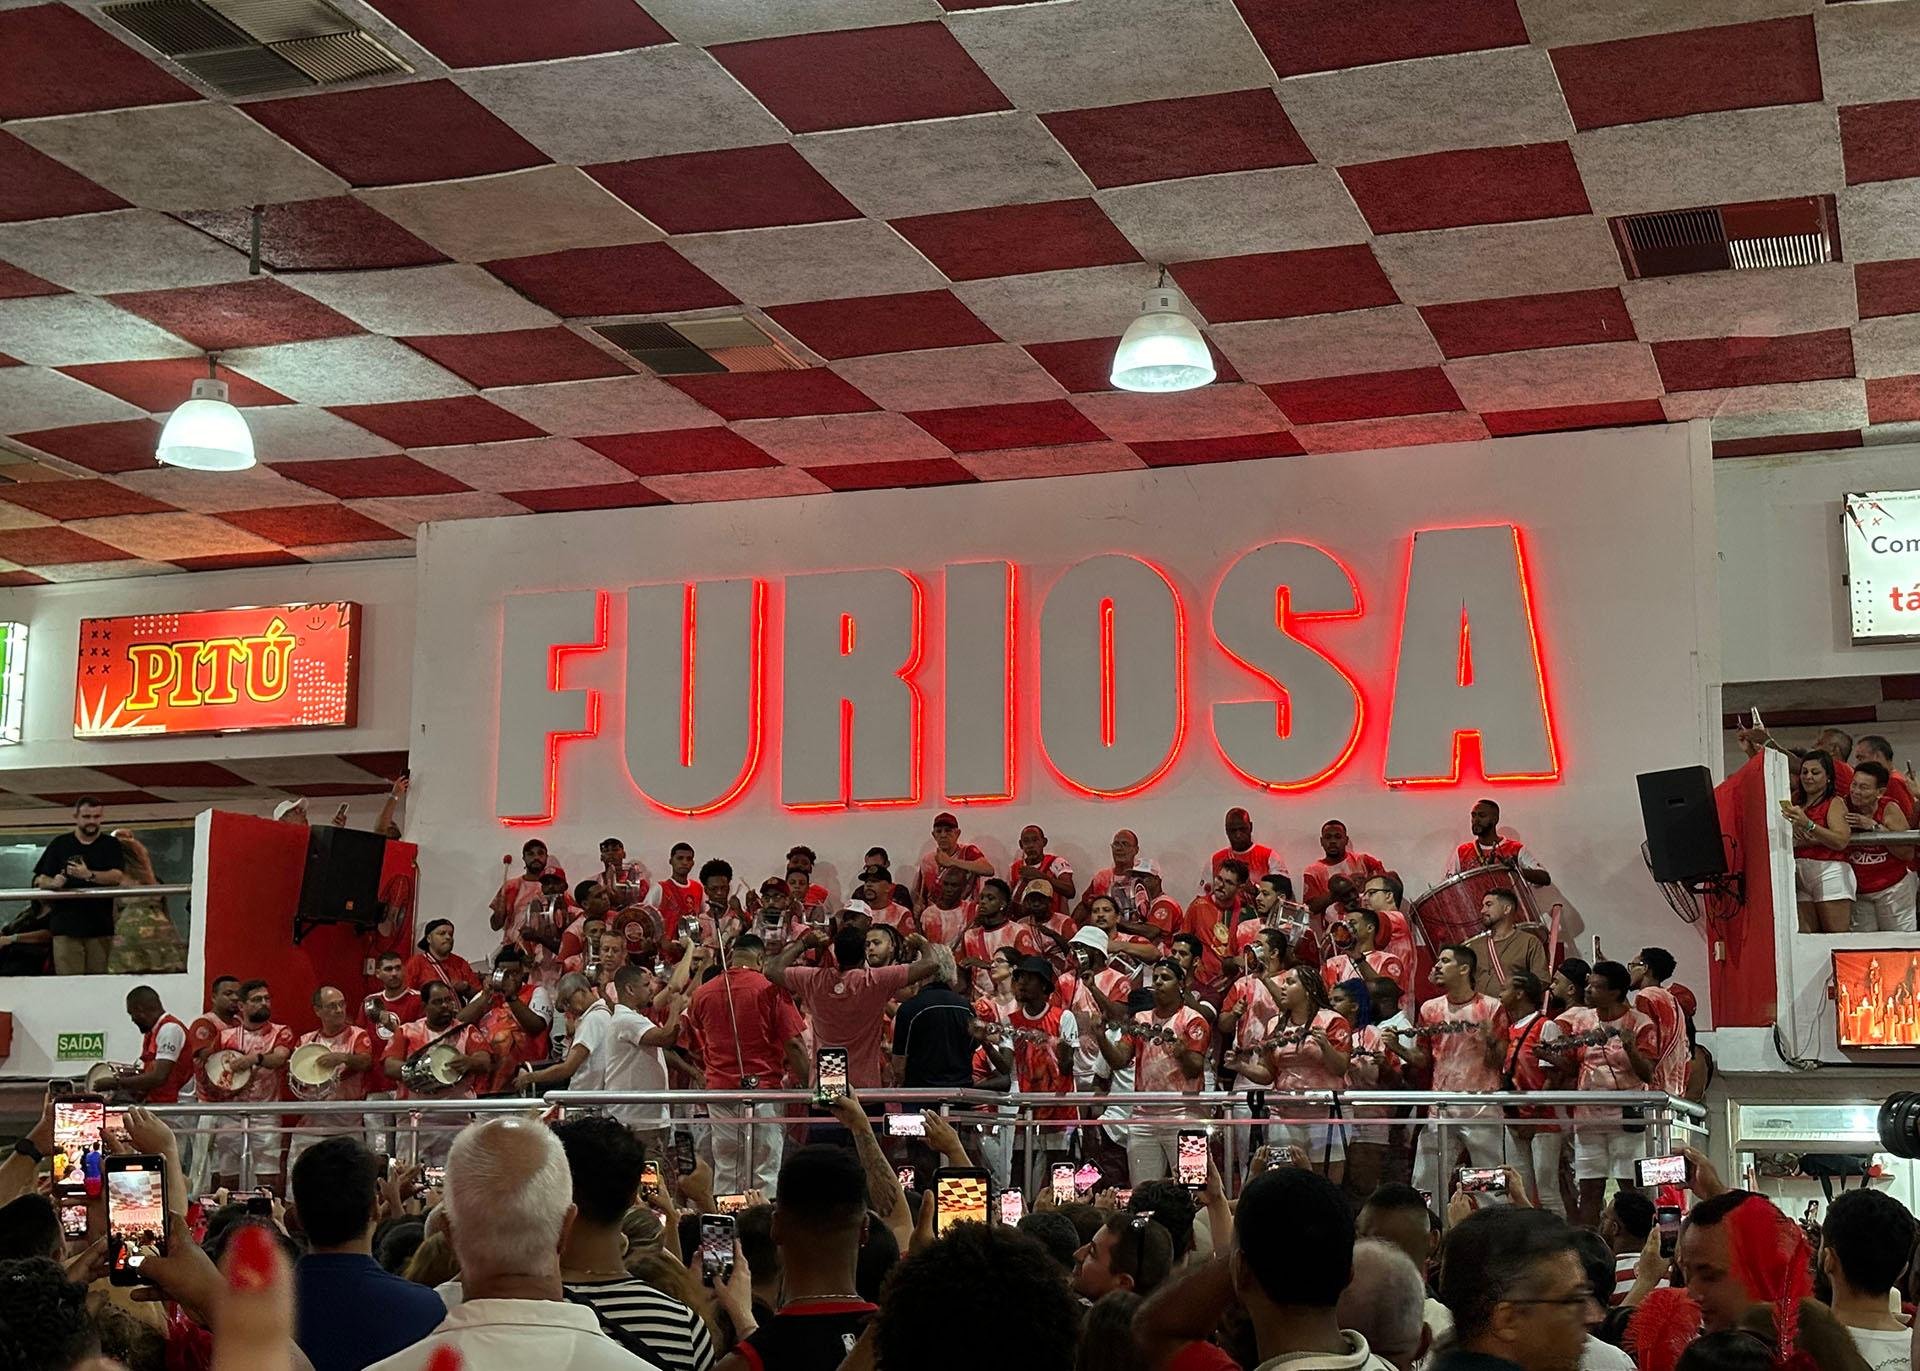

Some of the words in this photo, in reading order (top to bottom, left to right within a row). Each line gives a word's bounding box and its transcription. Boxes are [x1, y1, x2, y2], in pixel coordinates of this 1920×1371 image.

[125, 617, 296, 711] PITÚ
[496, 524, 1560, 826] FURIOSA
[59, 1034, 103, 1051] SAÍDA
